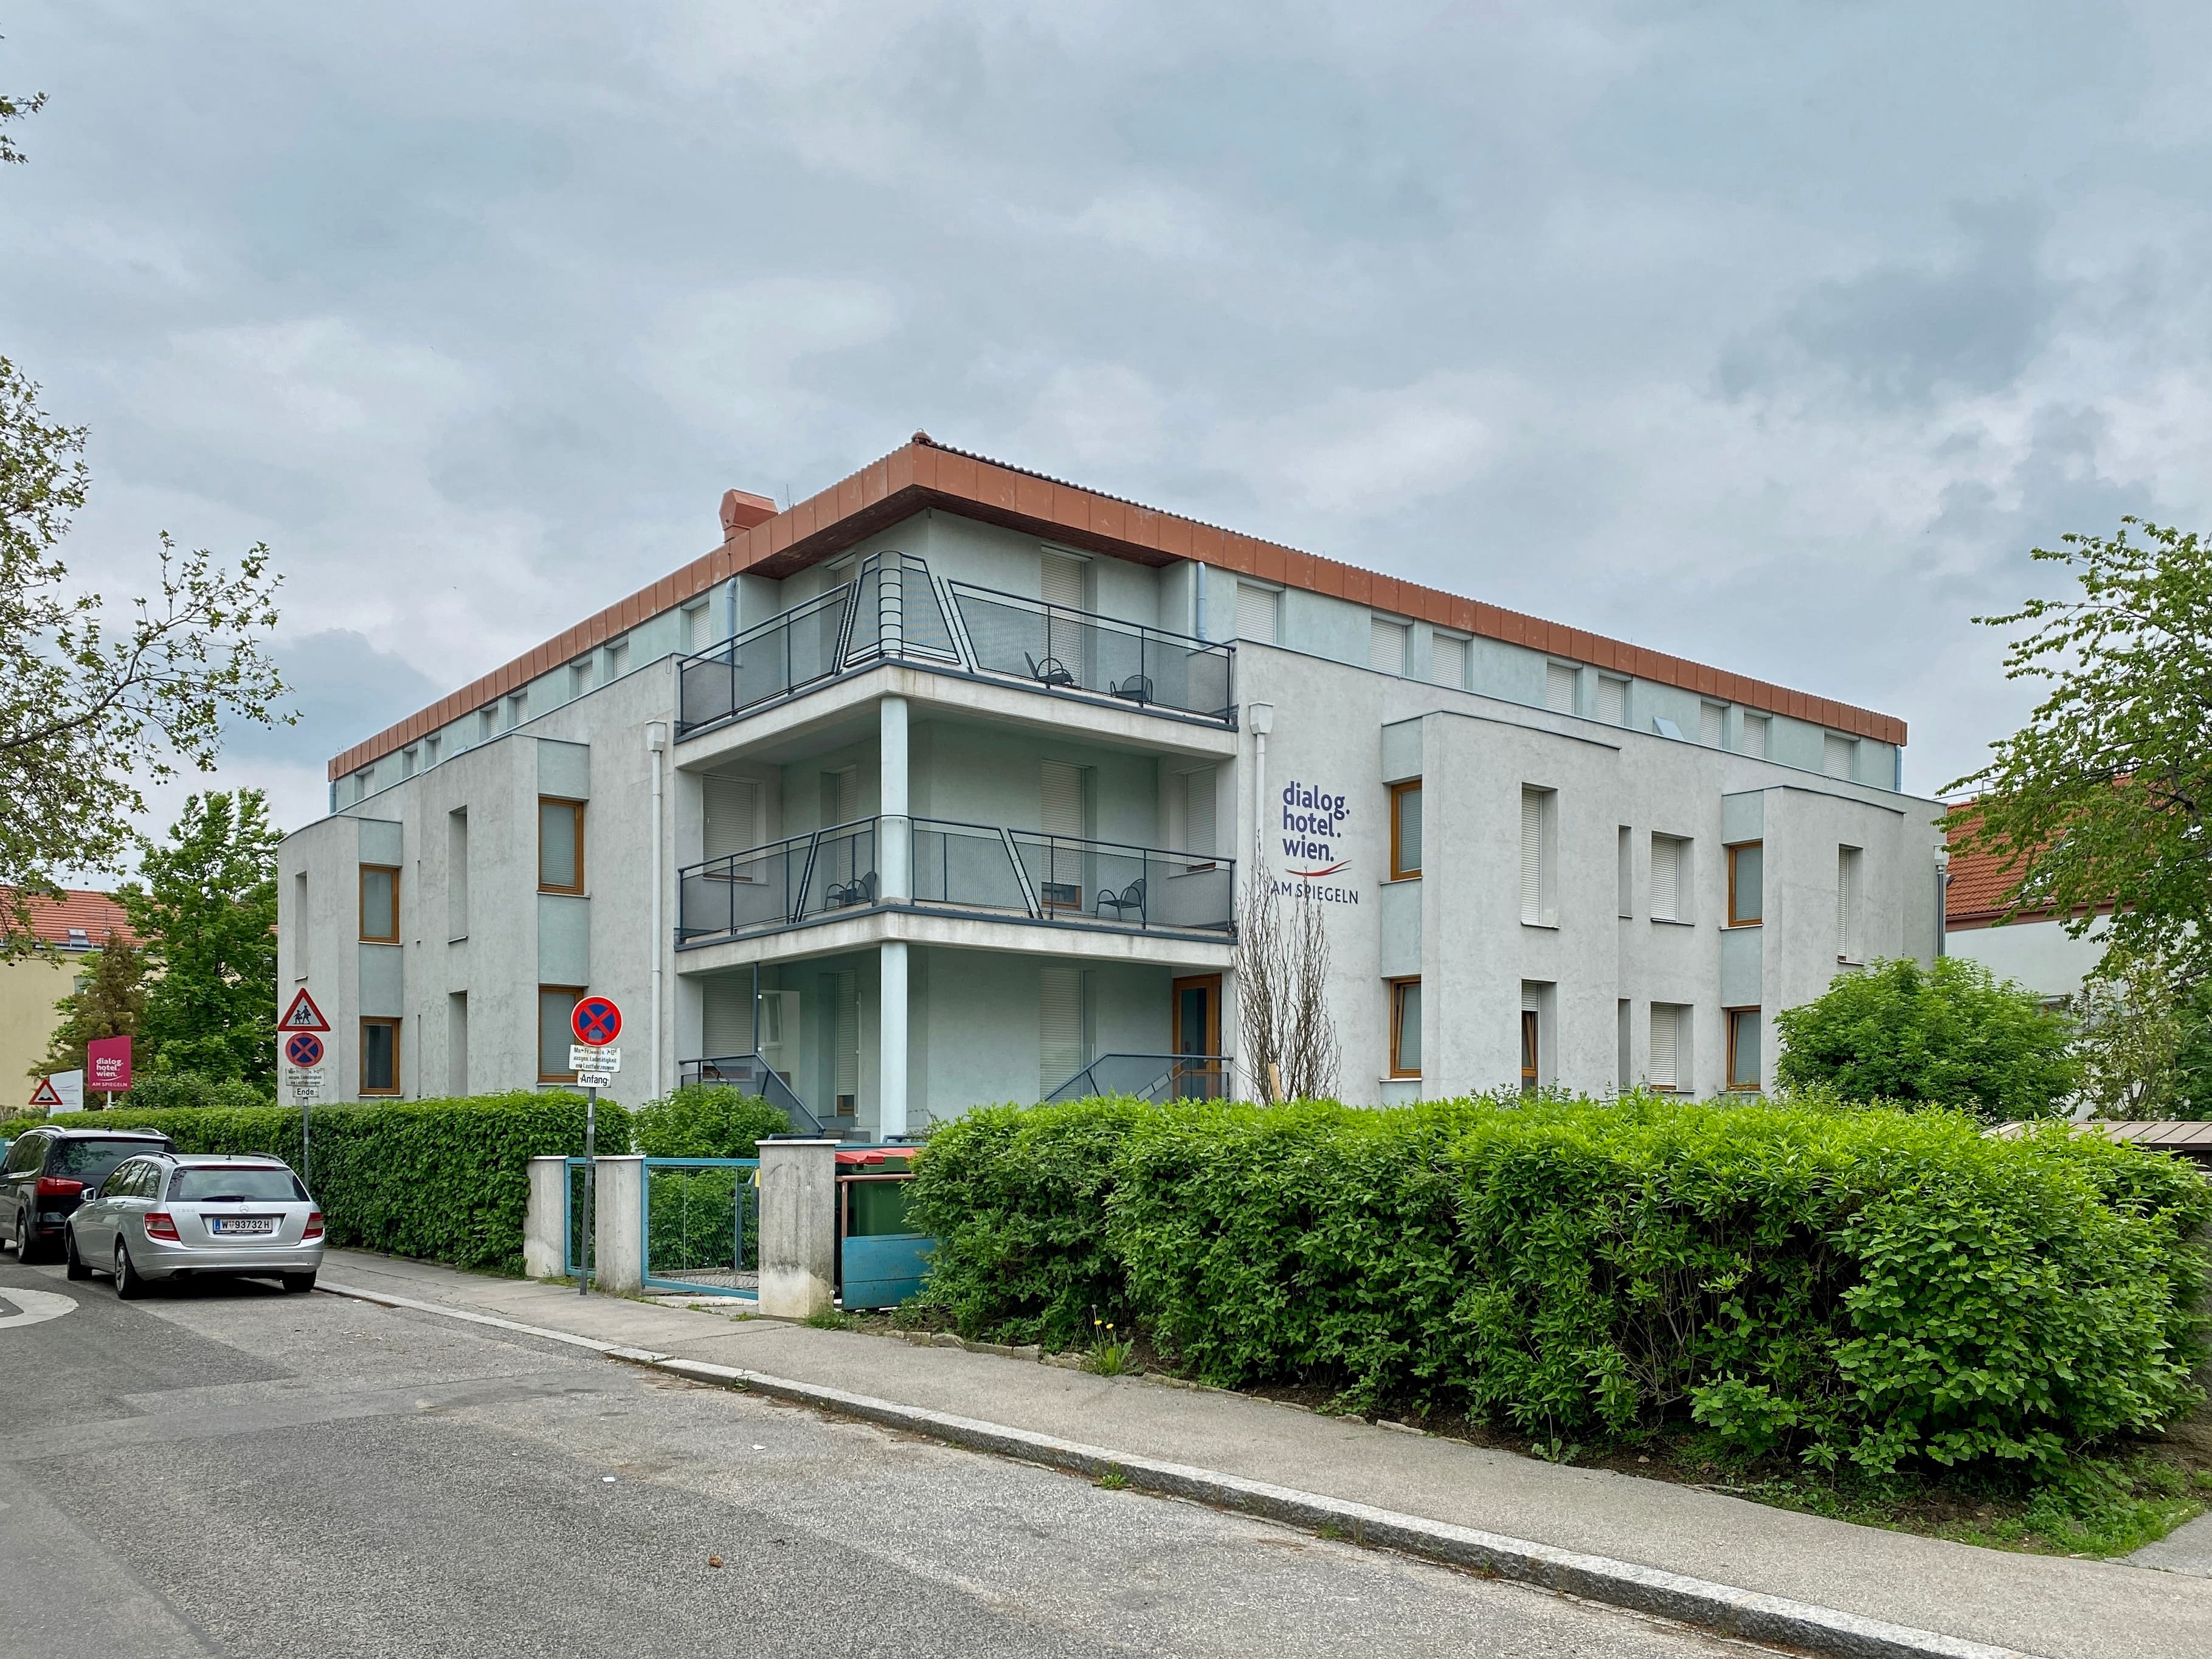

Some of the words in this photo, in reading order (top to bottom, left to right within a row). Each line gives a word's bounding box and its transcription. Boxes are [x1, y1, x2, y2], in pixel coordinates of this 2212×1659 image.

[1283, 781, 1350, 821] dialog.
[1283, 805, 1341, 838] hotel.
[1282, 834, 1335, 862] wien.
[1272, 881, 1292, 897] AM
[1296, 883, 1359, 905] SPIEGELN
[96, 1058, 123, 1066] dialog.
[581, 1074, 608, 1086] Anfang
